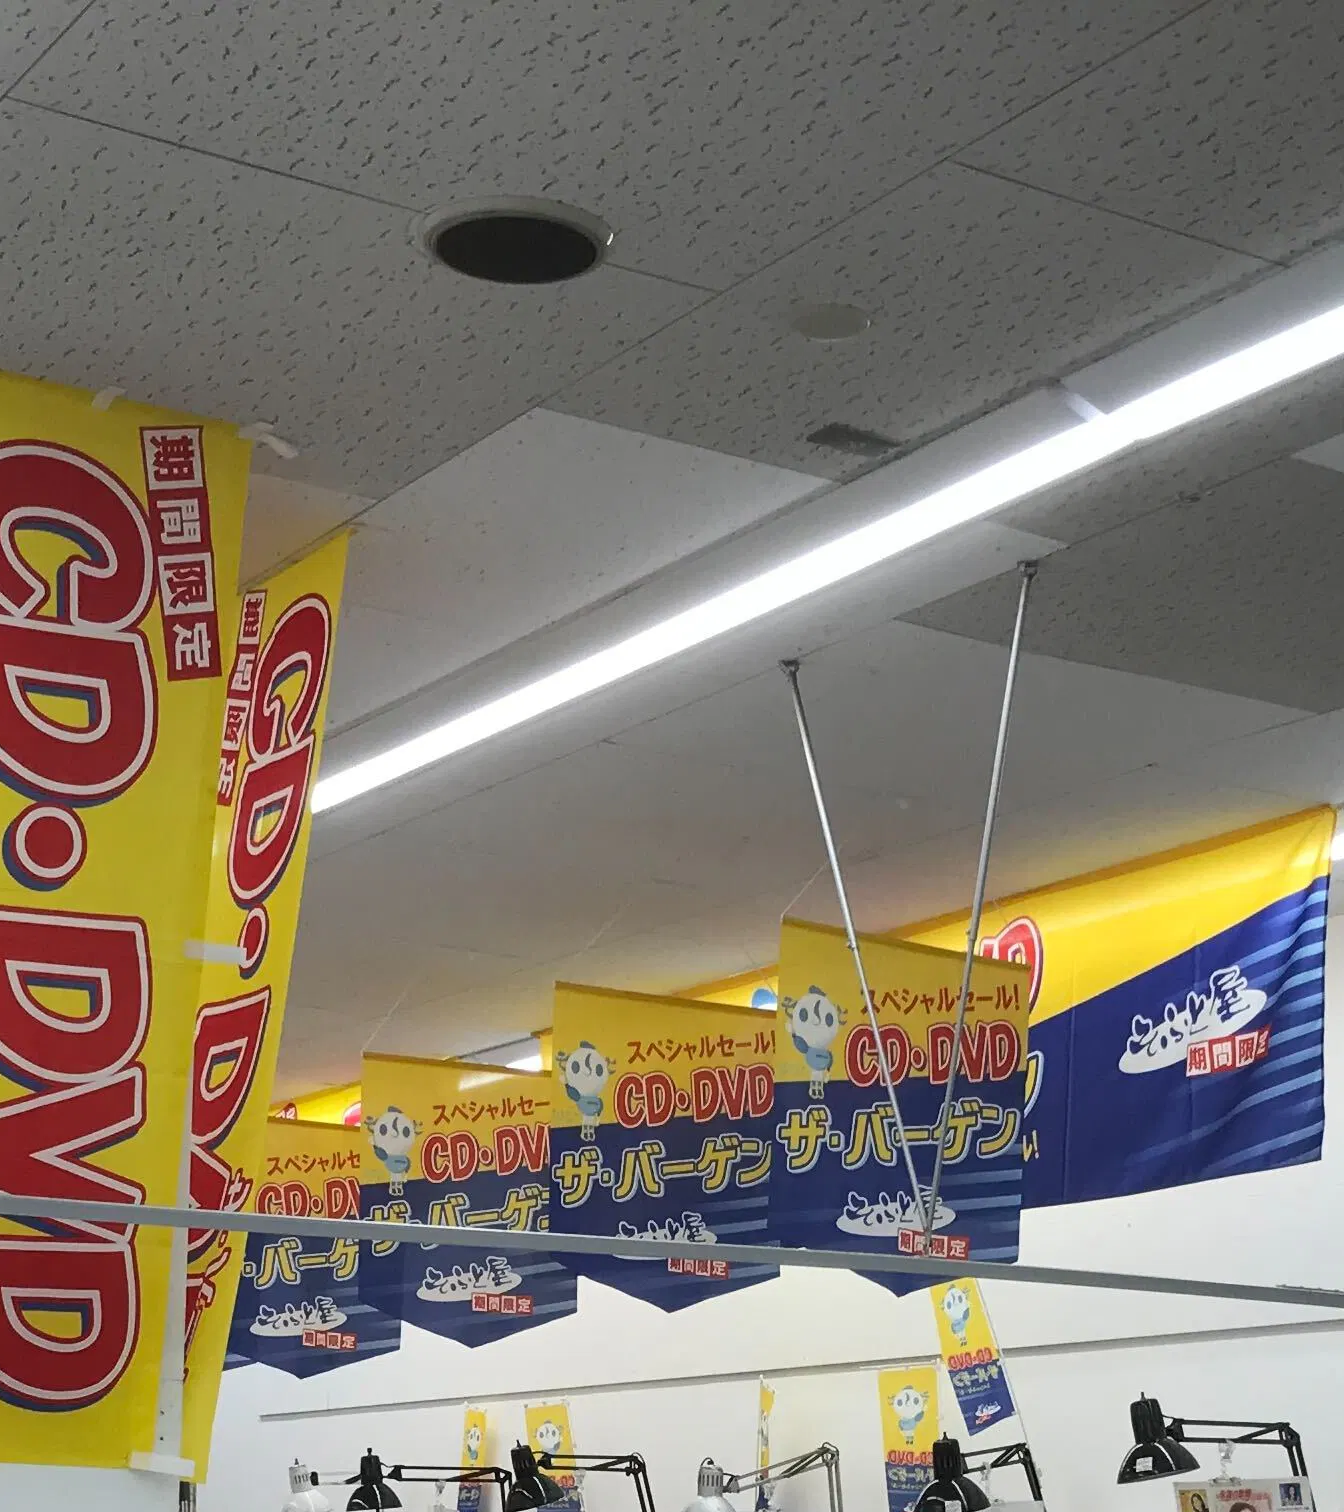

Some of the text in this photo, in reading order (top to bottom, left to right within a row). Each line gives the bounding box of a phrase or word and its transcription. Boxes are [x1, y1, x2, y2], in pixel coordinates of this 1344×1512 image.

[140, 425, 222, 681] 期間限定
[615, 1064, 774, 1128] CD・DVD
[422, 1122, 550, 1183] CD・DV
